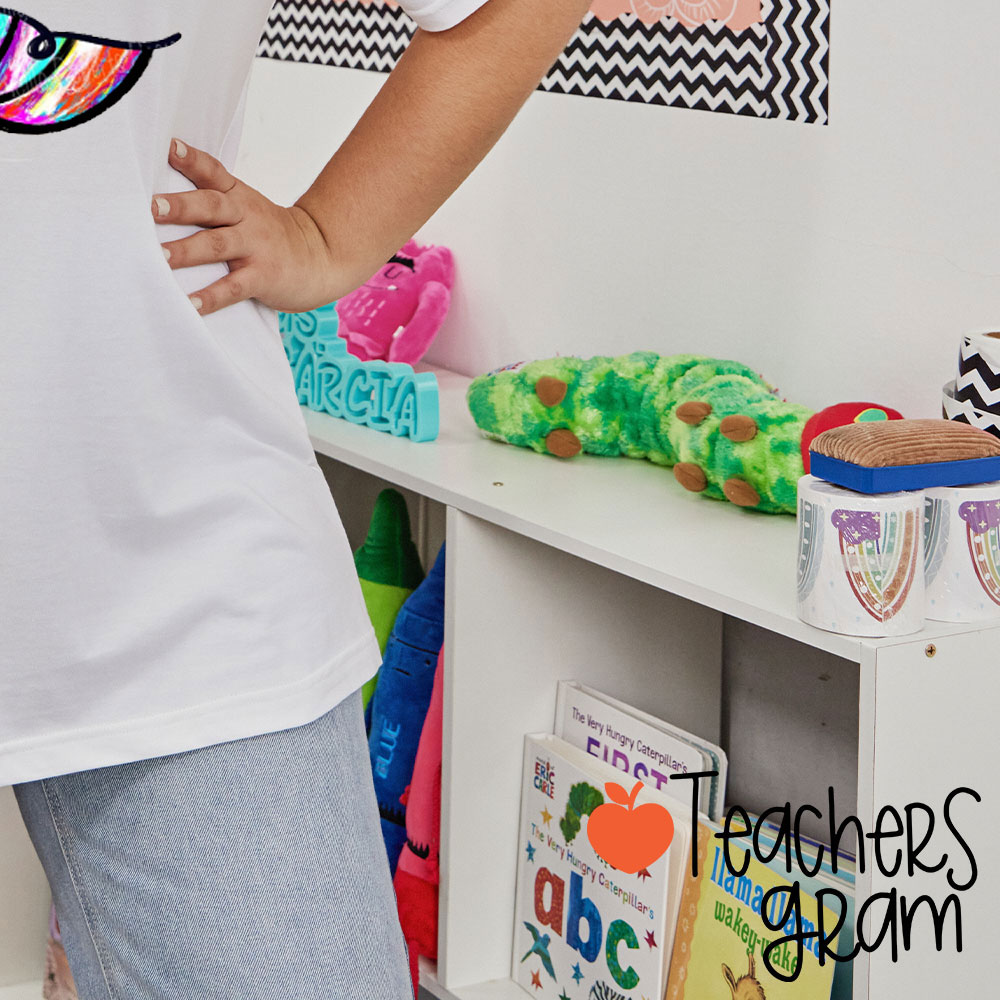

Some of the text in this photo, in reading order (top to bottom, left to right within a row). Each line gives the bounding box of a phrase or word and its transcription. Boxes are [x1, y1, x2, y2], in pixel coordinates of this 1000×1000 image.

[288, 352, 418, 437] ARCIA
[374, 717, 401, 780] BLUE
[572, 706, 688, 775] The Very Hungry Caterpillar's
[534, 775, 555, 800] CARLE
[531, 823, 654, 921] The Very Hungry Caterpillar's
[534, 866, 640, 990] abc
